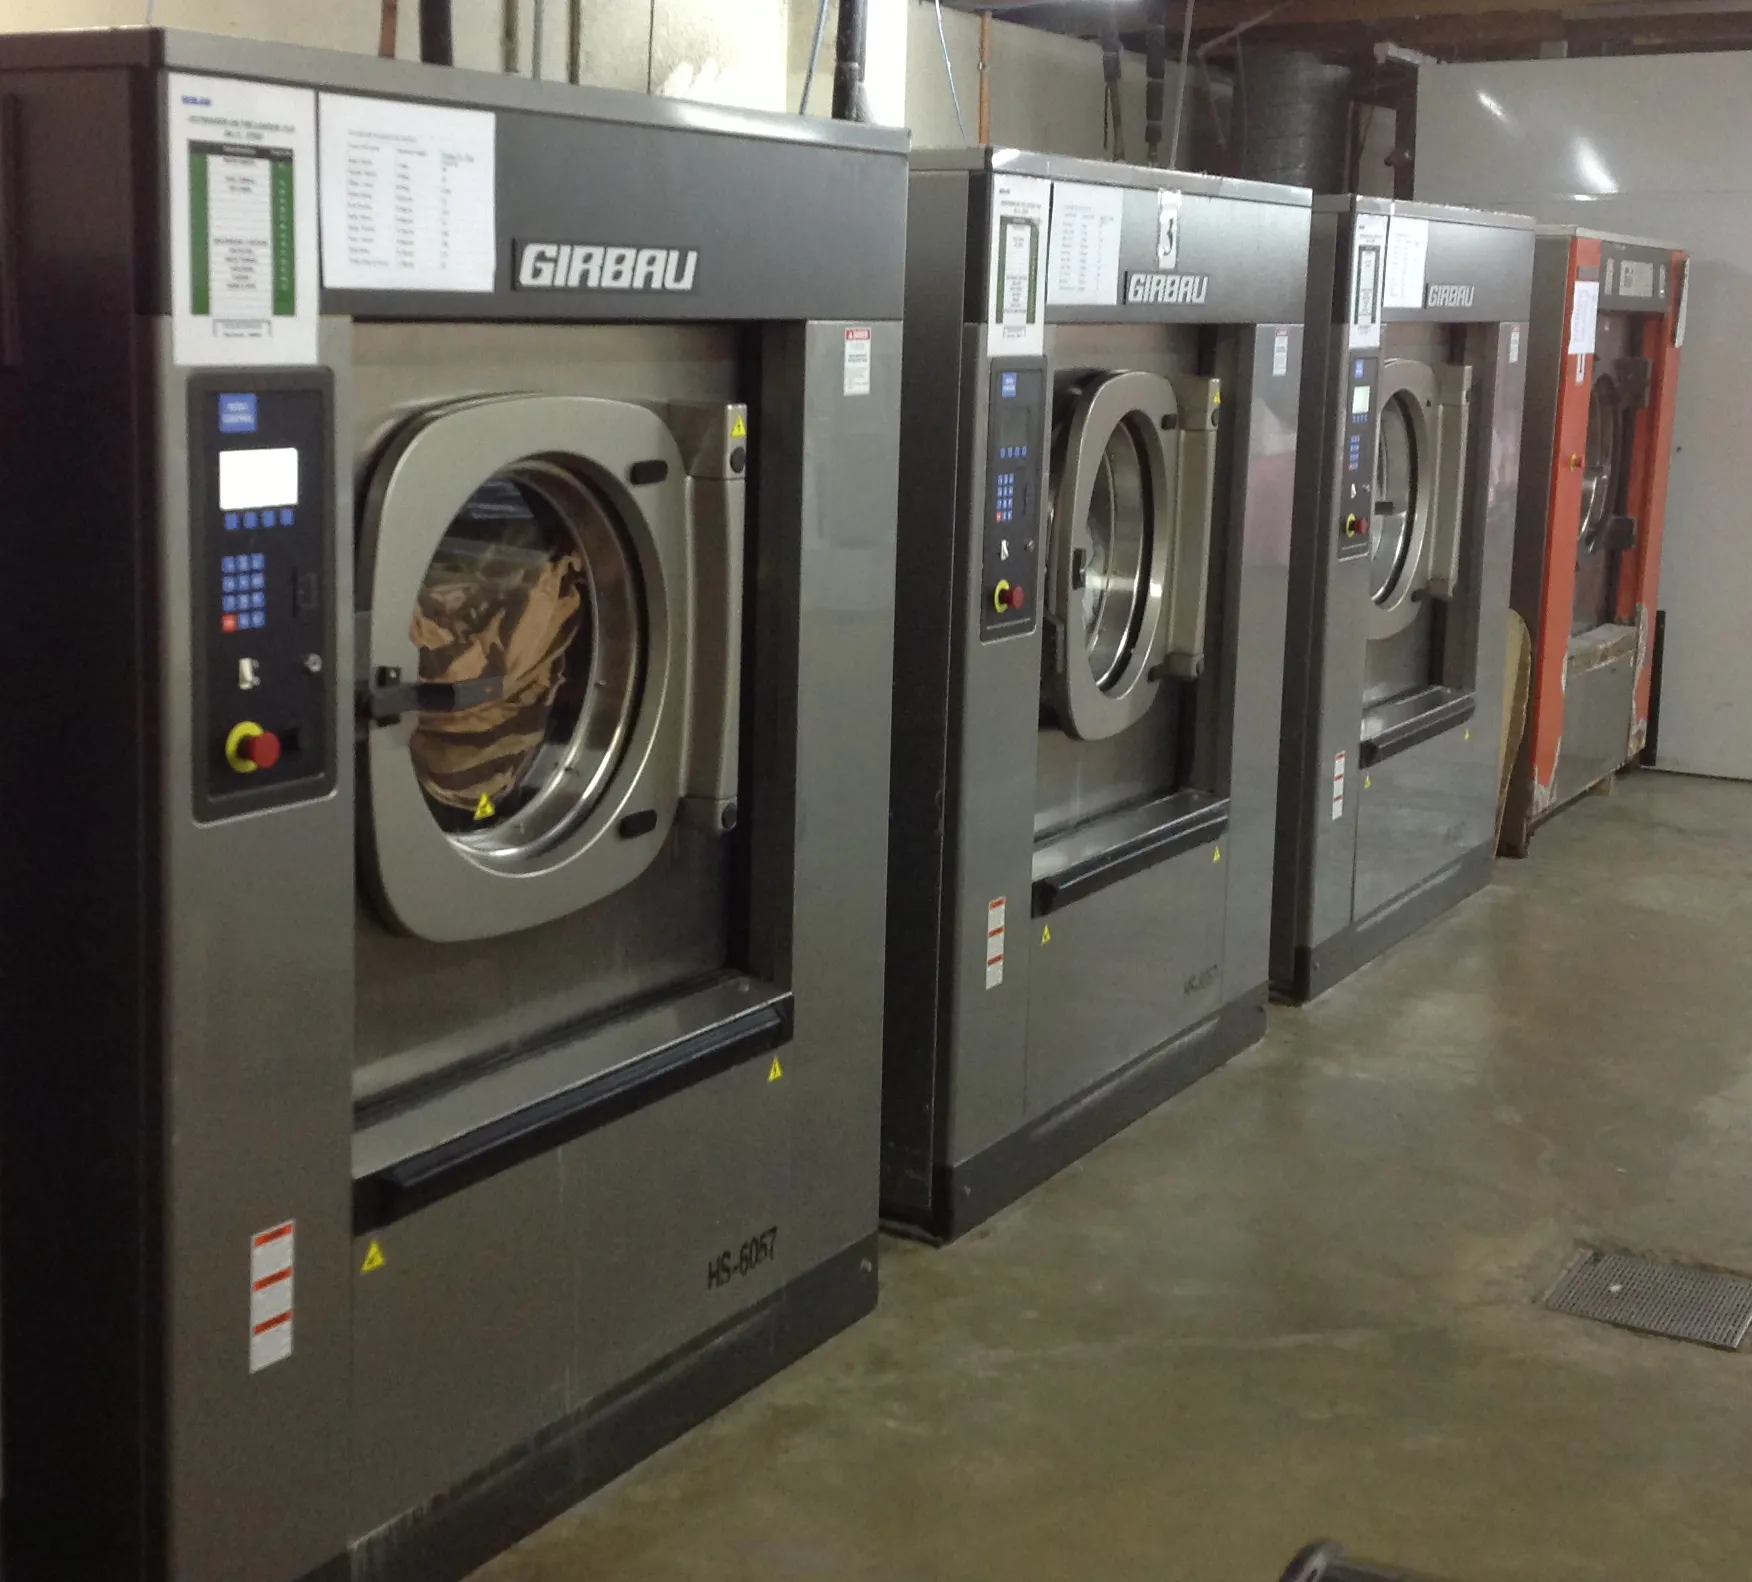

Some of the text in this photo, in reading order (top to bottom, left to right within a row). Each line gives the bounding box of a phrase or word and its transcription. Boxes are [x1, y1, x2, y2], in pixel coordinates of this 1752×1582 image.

[519, 243, 699, 291] GIRBAU
[1128, 274, 1209, 304] GIRBAU
[1428, 284, 1475, 307] GIRBAU
[708, 1226, 778, 1290] HS-6057
